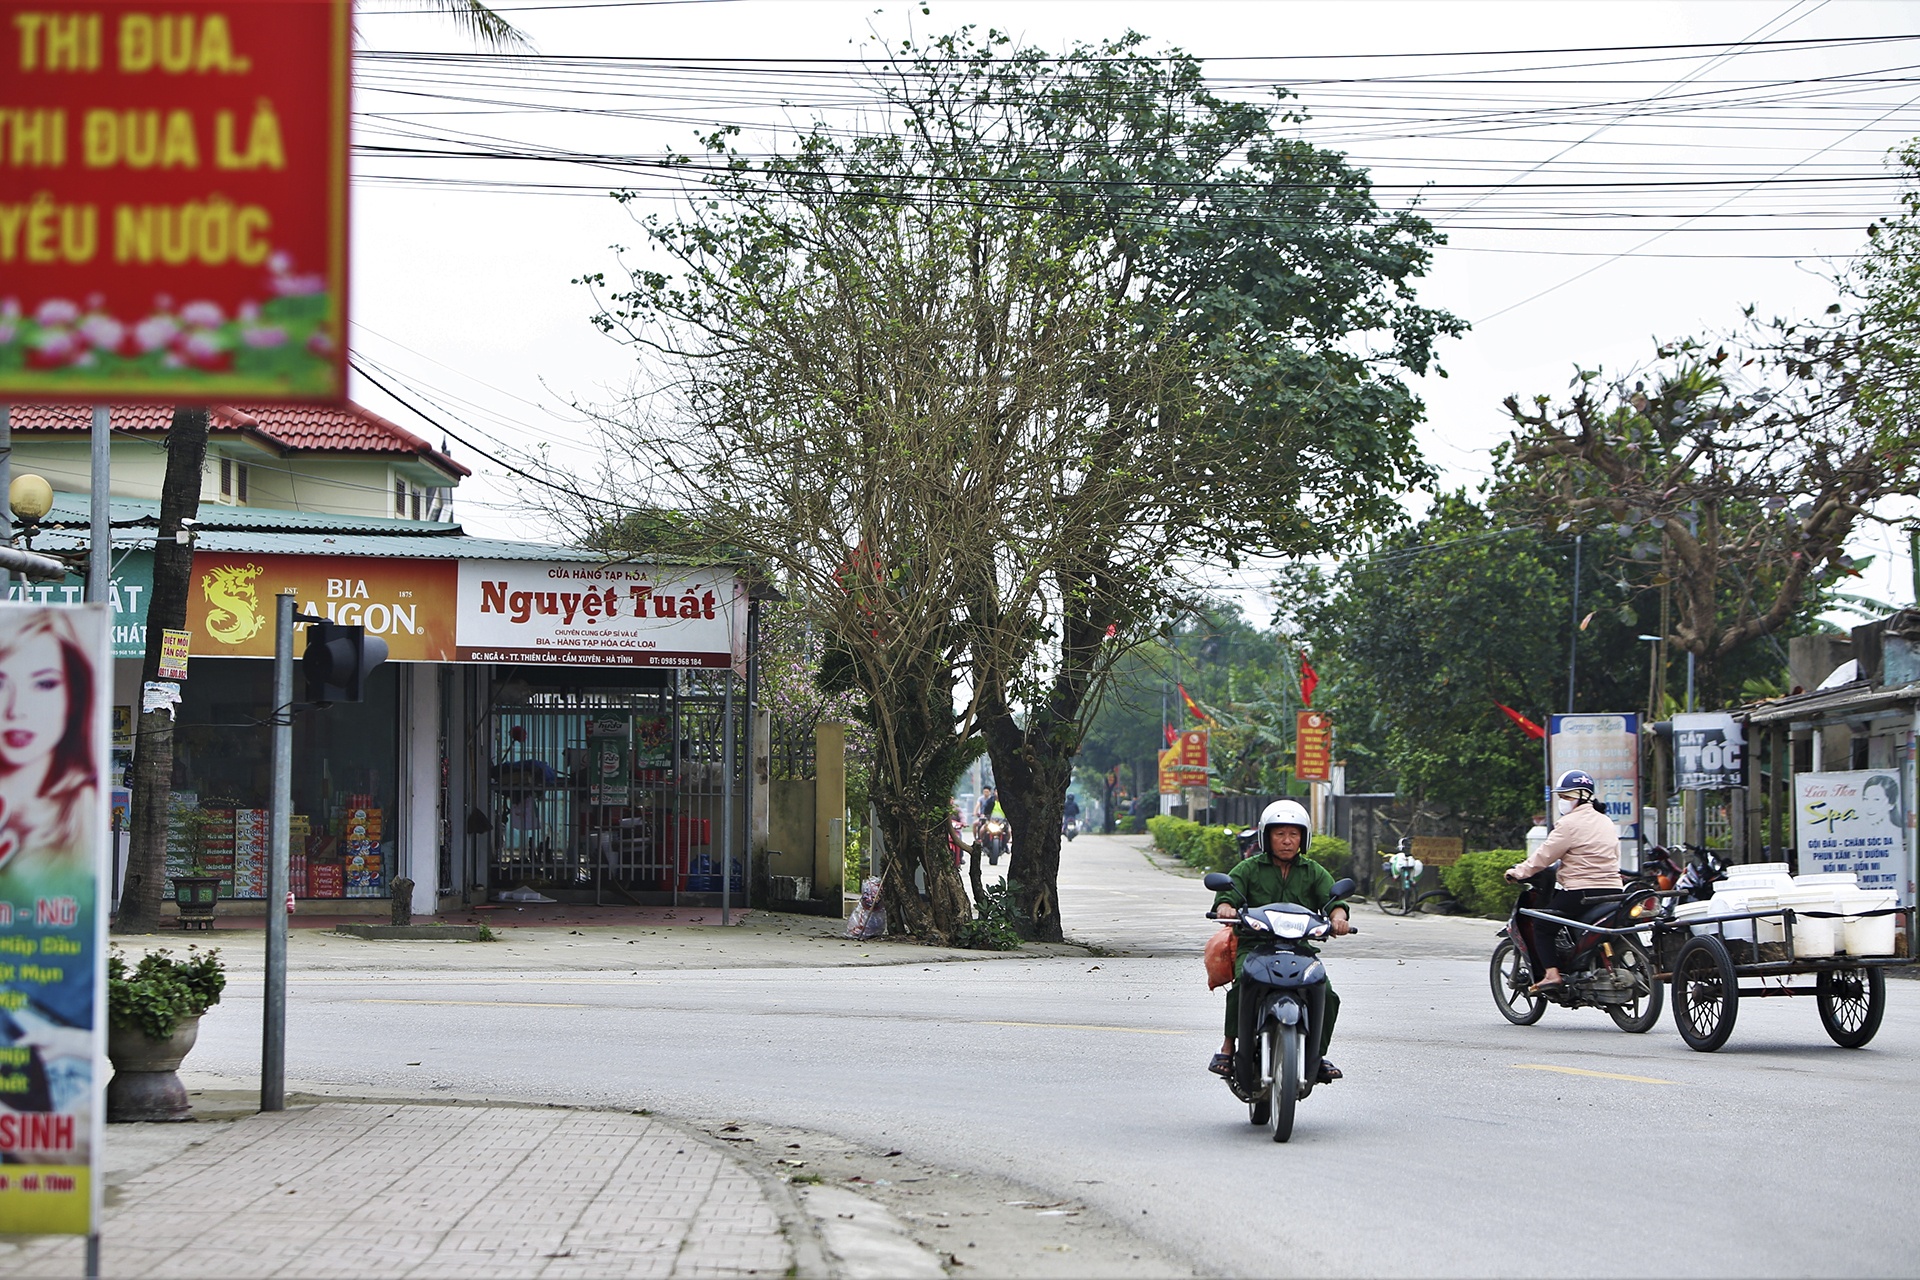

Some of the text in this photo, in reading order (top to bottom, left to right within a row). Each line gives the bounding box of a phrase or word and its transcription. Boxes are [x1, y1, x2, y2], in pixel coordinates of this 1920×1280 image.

[14, 12, 101, 72] THI
[84, 108, 197, 168] ĐUA
[215, 97, 285, 169] LÀ
[115, 194, 270, 265] NƯỚC
[327, 578, 370, 599] BIA
[548, 567, 648, 583] CỬA HÀNG TẠP HÓA
[293, 601, 417, 635] AIGON
[481, 581, 716, 626] Nguyệt Tuất
[557, 636, 580, 646] HÀNG
[582, 638, 599, 648] TẠP
[601, 638, 618, 647] HÓA
[620, 638, 635, 648] CÁC
[637, 640, 656, 649] LOẠI
[600, 628, 612, 637] CẤP
[621, 629, 629, 638] VÀ
[471, 652, 483, 660] ĐC:
[484, 651, 498, 660] NGÃ
[520, 652, 541, 662] THIÊN
[579, 653, 601, 663] XUYÊN
[606, 654, 616, 663] HÀ
[649, 656, 660, 664] ĐT:
[661, 657, 677, 665] 0985
[678, 657, 689, 665] 968
[691, 658, 702, 666] 184
[1679, 739, 1742, 770] TÓC
[1804, 800, 1859, 833] Spa
[0, 1113, 74, 1150] SINH
